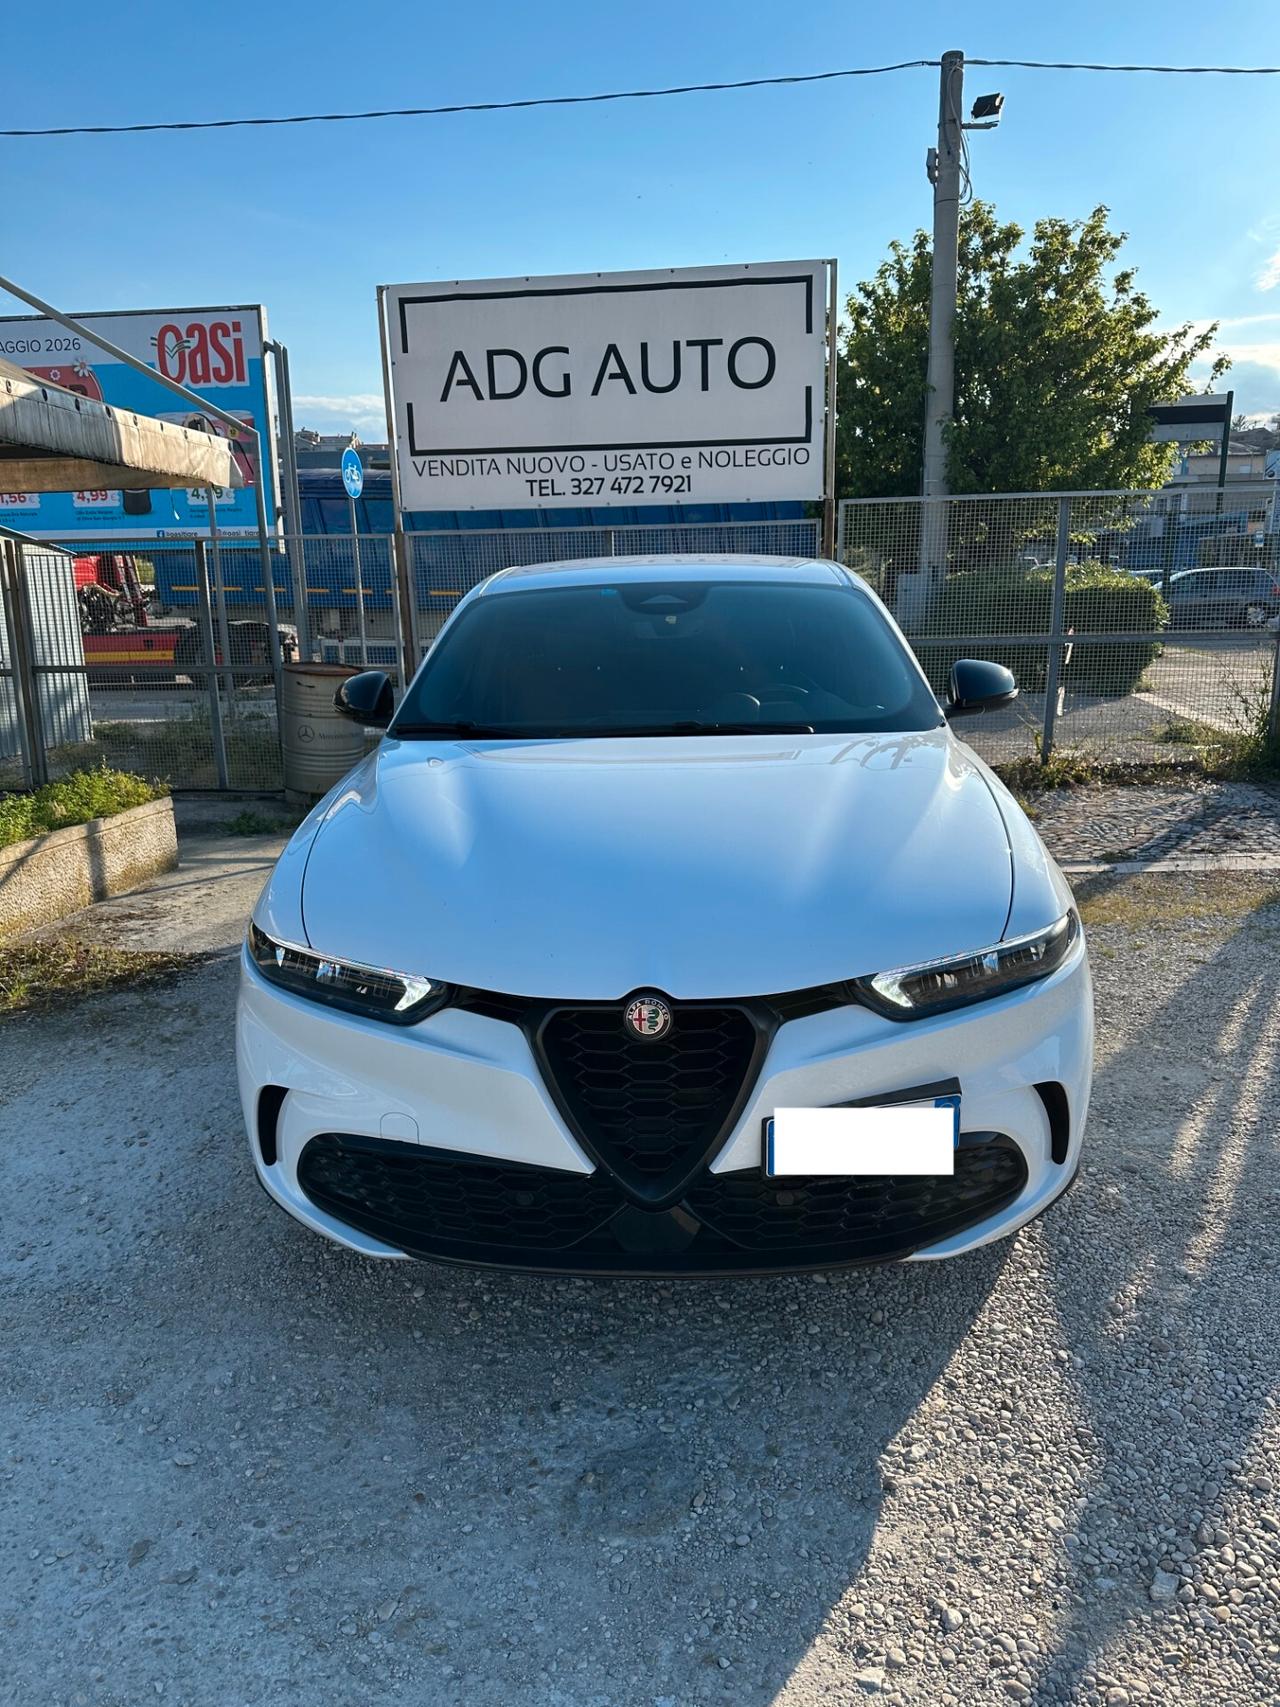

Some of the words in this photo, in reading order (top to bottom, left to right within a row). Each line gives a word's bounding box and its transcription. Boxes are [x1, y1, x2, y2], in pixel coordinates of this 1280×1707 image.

[45, 337, 81, 352] 2026
[440, 346, 572, 402] ADG
[590, 336, 776, 397] AUTO
[412, 457, 502, 477] VENDITA
[506, 455, 585, 475] NUOVO
[604, 452, 675, 472] USATO
[681, 455, 692, 469] e
[698, 447, 810, 469] NOLEGGIO
[76, 490, 108, 503] 4,99
[525, 478, 566, 497] TEL.
[570, 477, 605, 496] 327
[610, 476, 644, 494] 472
[649, 474, 691, 493] 7921
[644, 999, 669, 1020] ROMEO
